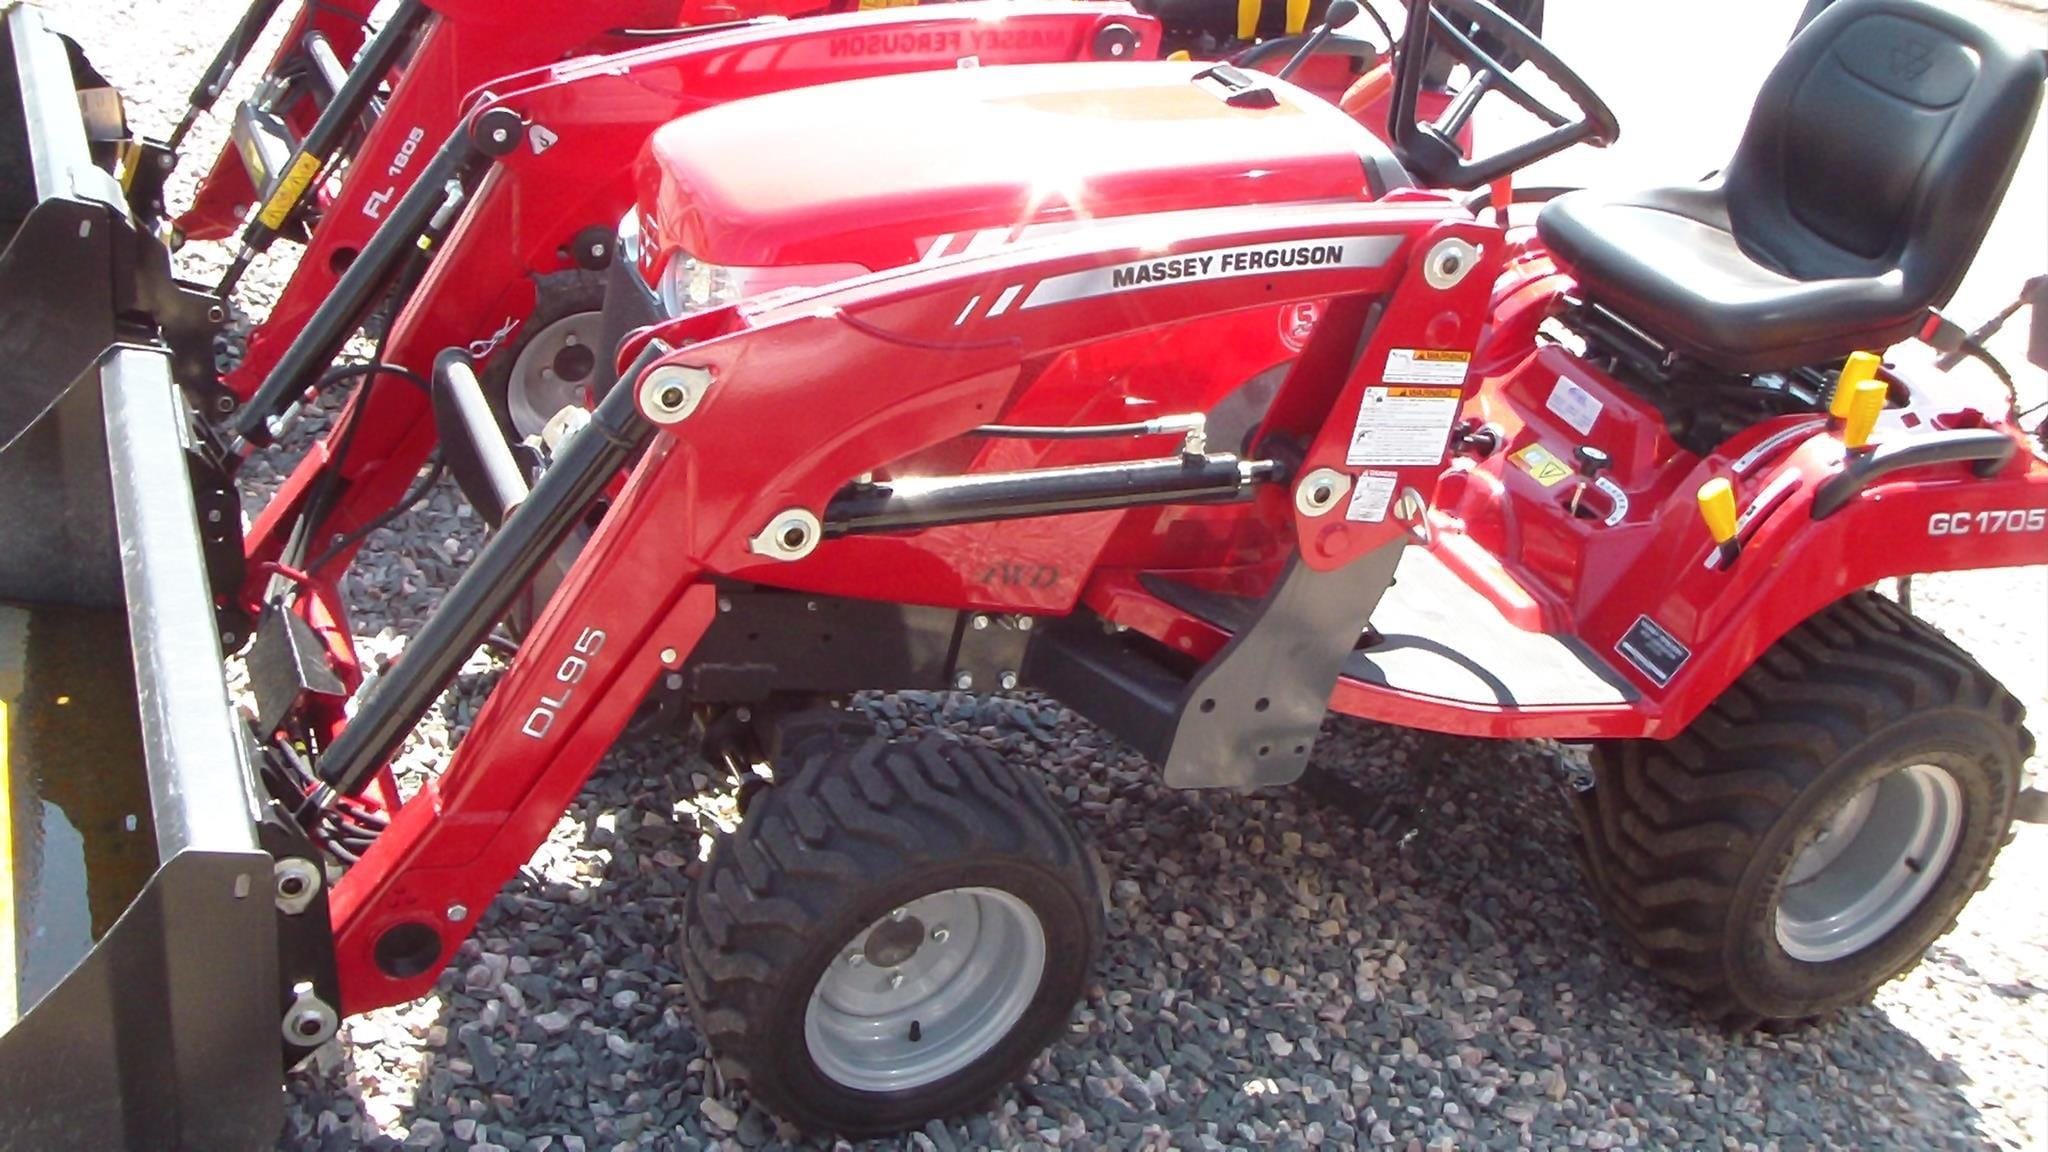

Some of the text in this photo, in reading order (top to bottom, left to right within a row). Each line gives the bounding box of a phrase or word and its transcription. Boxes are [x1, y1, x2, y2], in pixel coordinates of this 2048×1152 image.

[362, 186, 395, 219] FL
[1112, 245, 1344, 288] MASSEY FERGUSON
[521, 626, 607, 739] DL95
